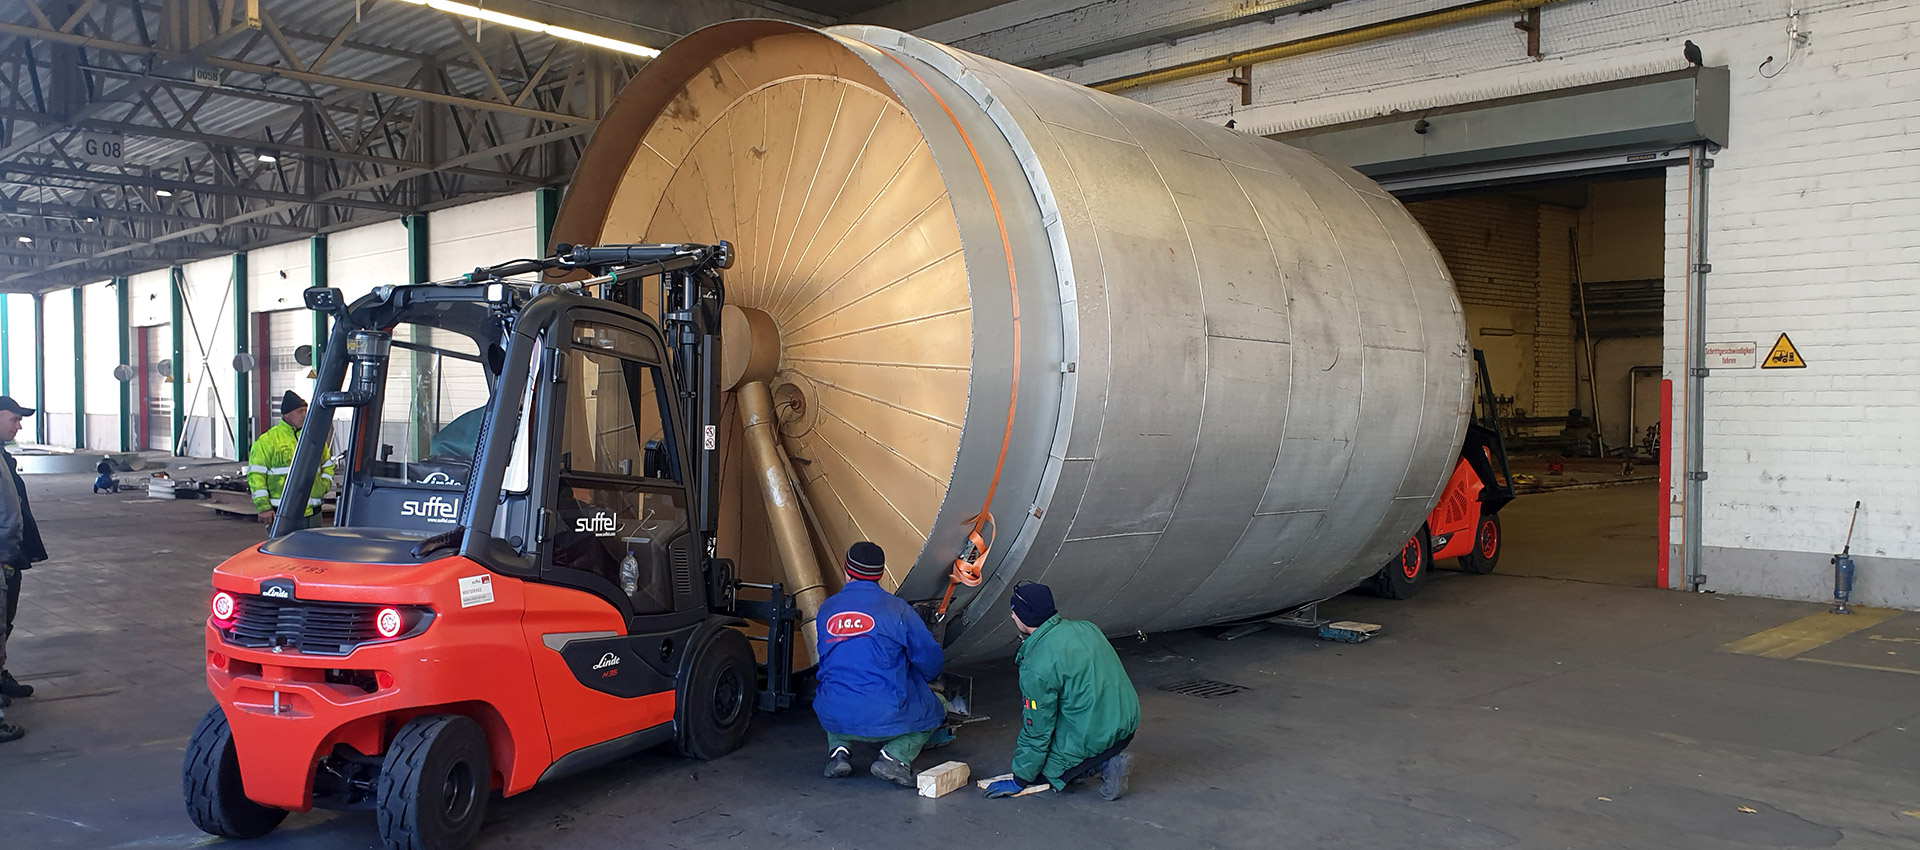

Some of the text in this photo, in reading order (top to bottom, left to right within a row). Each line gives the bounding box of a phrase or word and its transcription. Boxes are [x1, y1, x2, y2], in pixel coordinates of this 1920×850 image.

[86, 139, 121, 158] G 08
[400, 496, 459, 518] suffel
[575, 511, 617, 532] suffel
[262, 585, 289, 598] Linde
[592, 652, 621, 670] Linde
